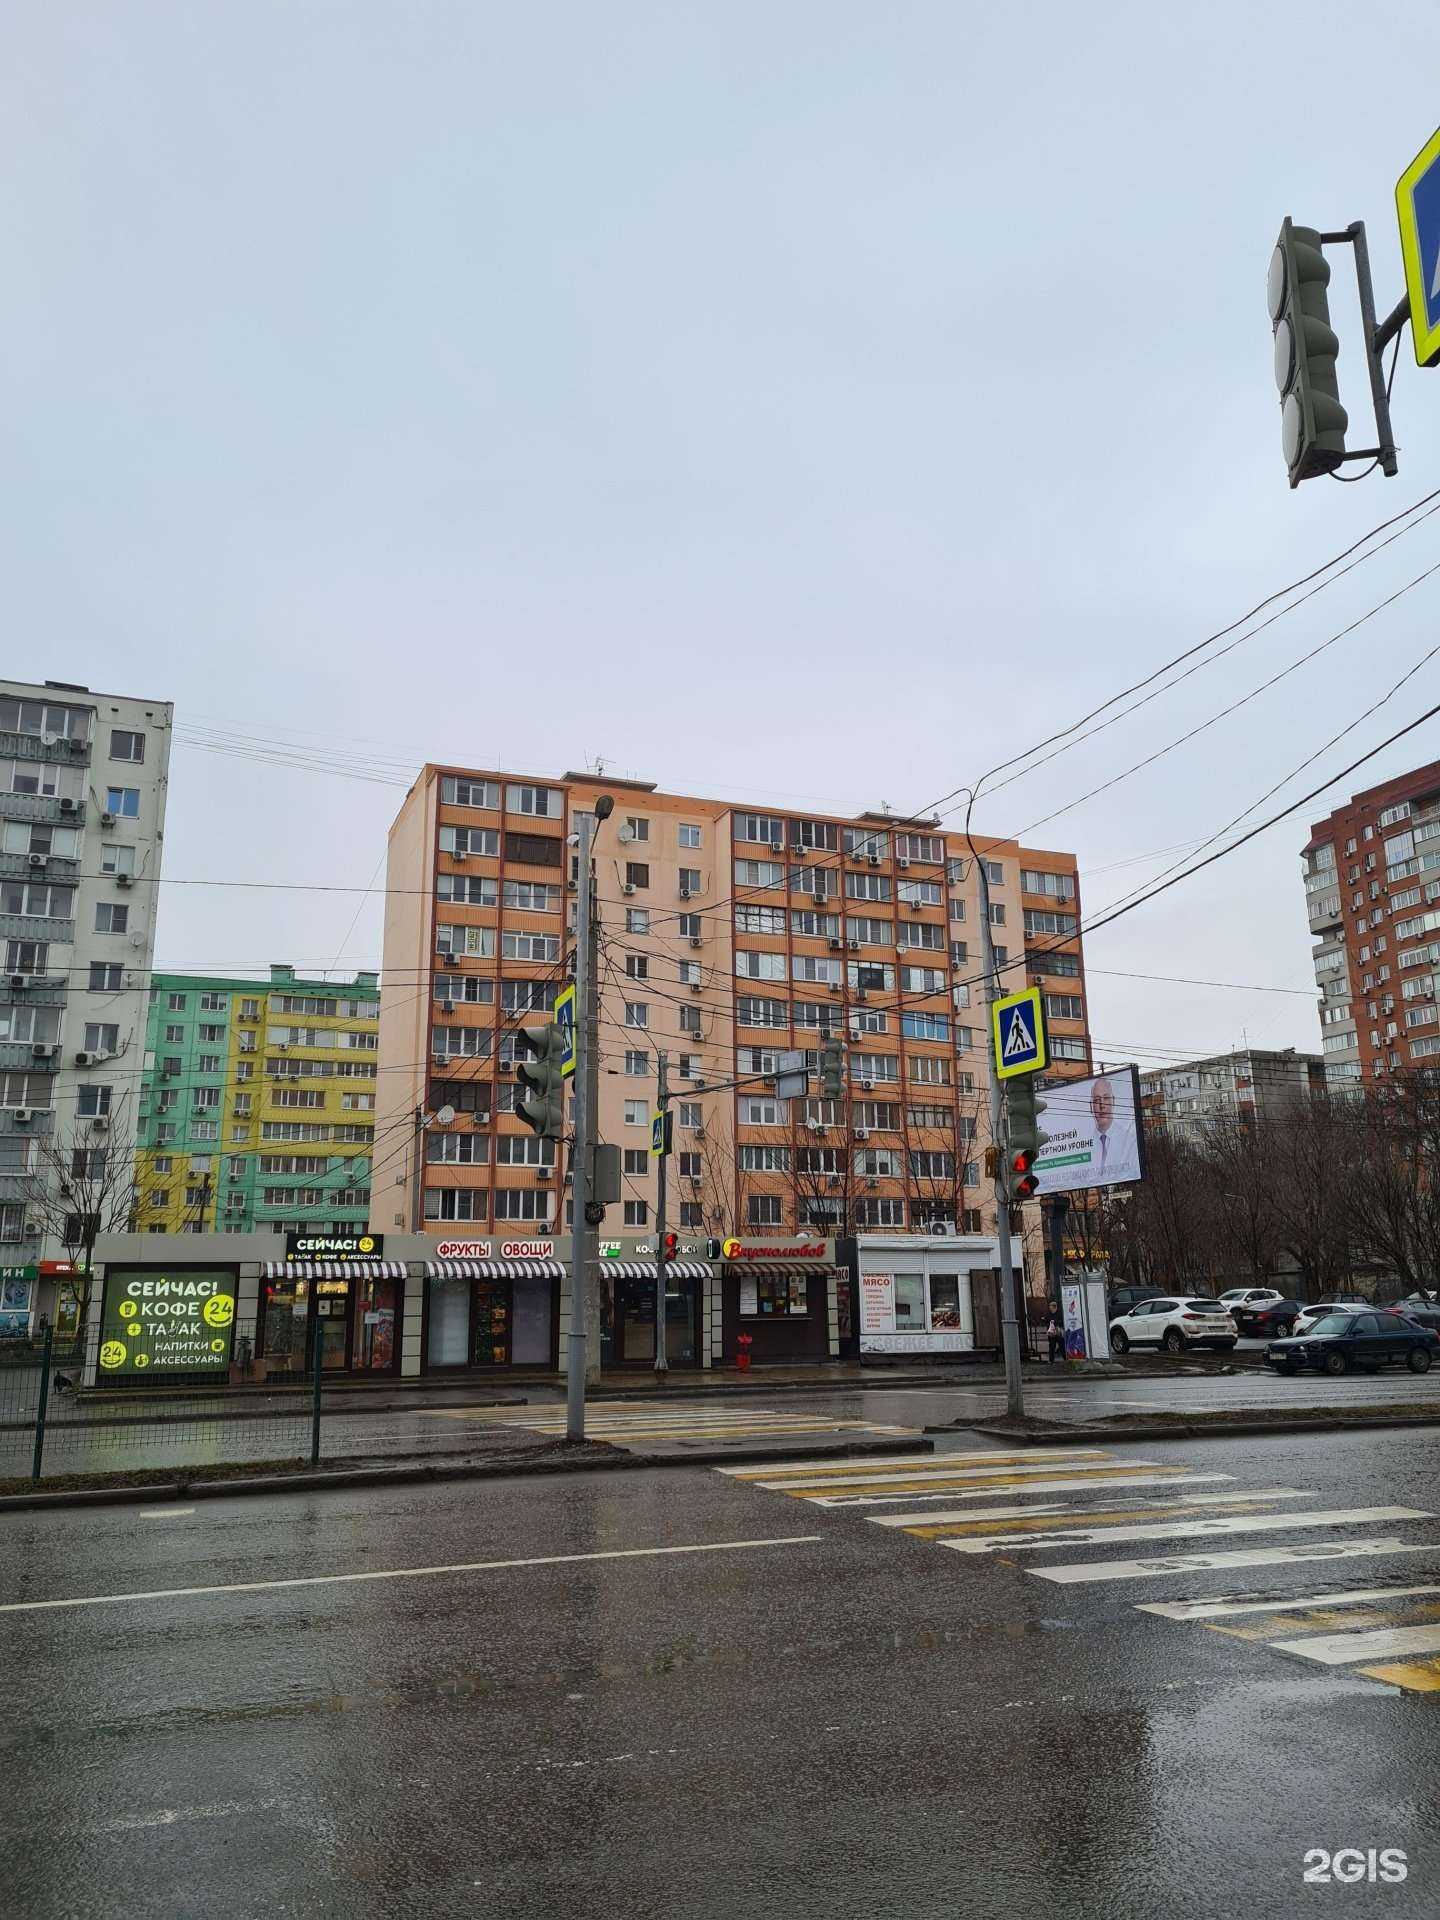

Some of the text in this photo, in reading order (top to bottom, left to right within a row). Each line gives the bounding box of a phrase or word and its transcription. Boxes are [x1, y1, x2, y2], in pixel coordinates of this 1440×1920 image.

[1048, 1128, 1077, 1143] ОЛЕЗНЕЙ
[1068, 1139, 1094, 1151] УРОВНЕ
[296, 1237, 357, 1250] СЕЙЧАС!
[438, 1242, 553, 1257] ФРУКТЫ ОВОЩИ
[127, 1279, 218, 1297] СЕЙЧАС!
[141, 1301, 200, 1316] КОФЕ
[210, 1301, 232, 1315] 24
[103, 1346, 121, 1358] 24
[155, 1341, 209, 1351] НАПИТКИ
[154, 1355, 223, 1365] АКСЕССУАРЫ
